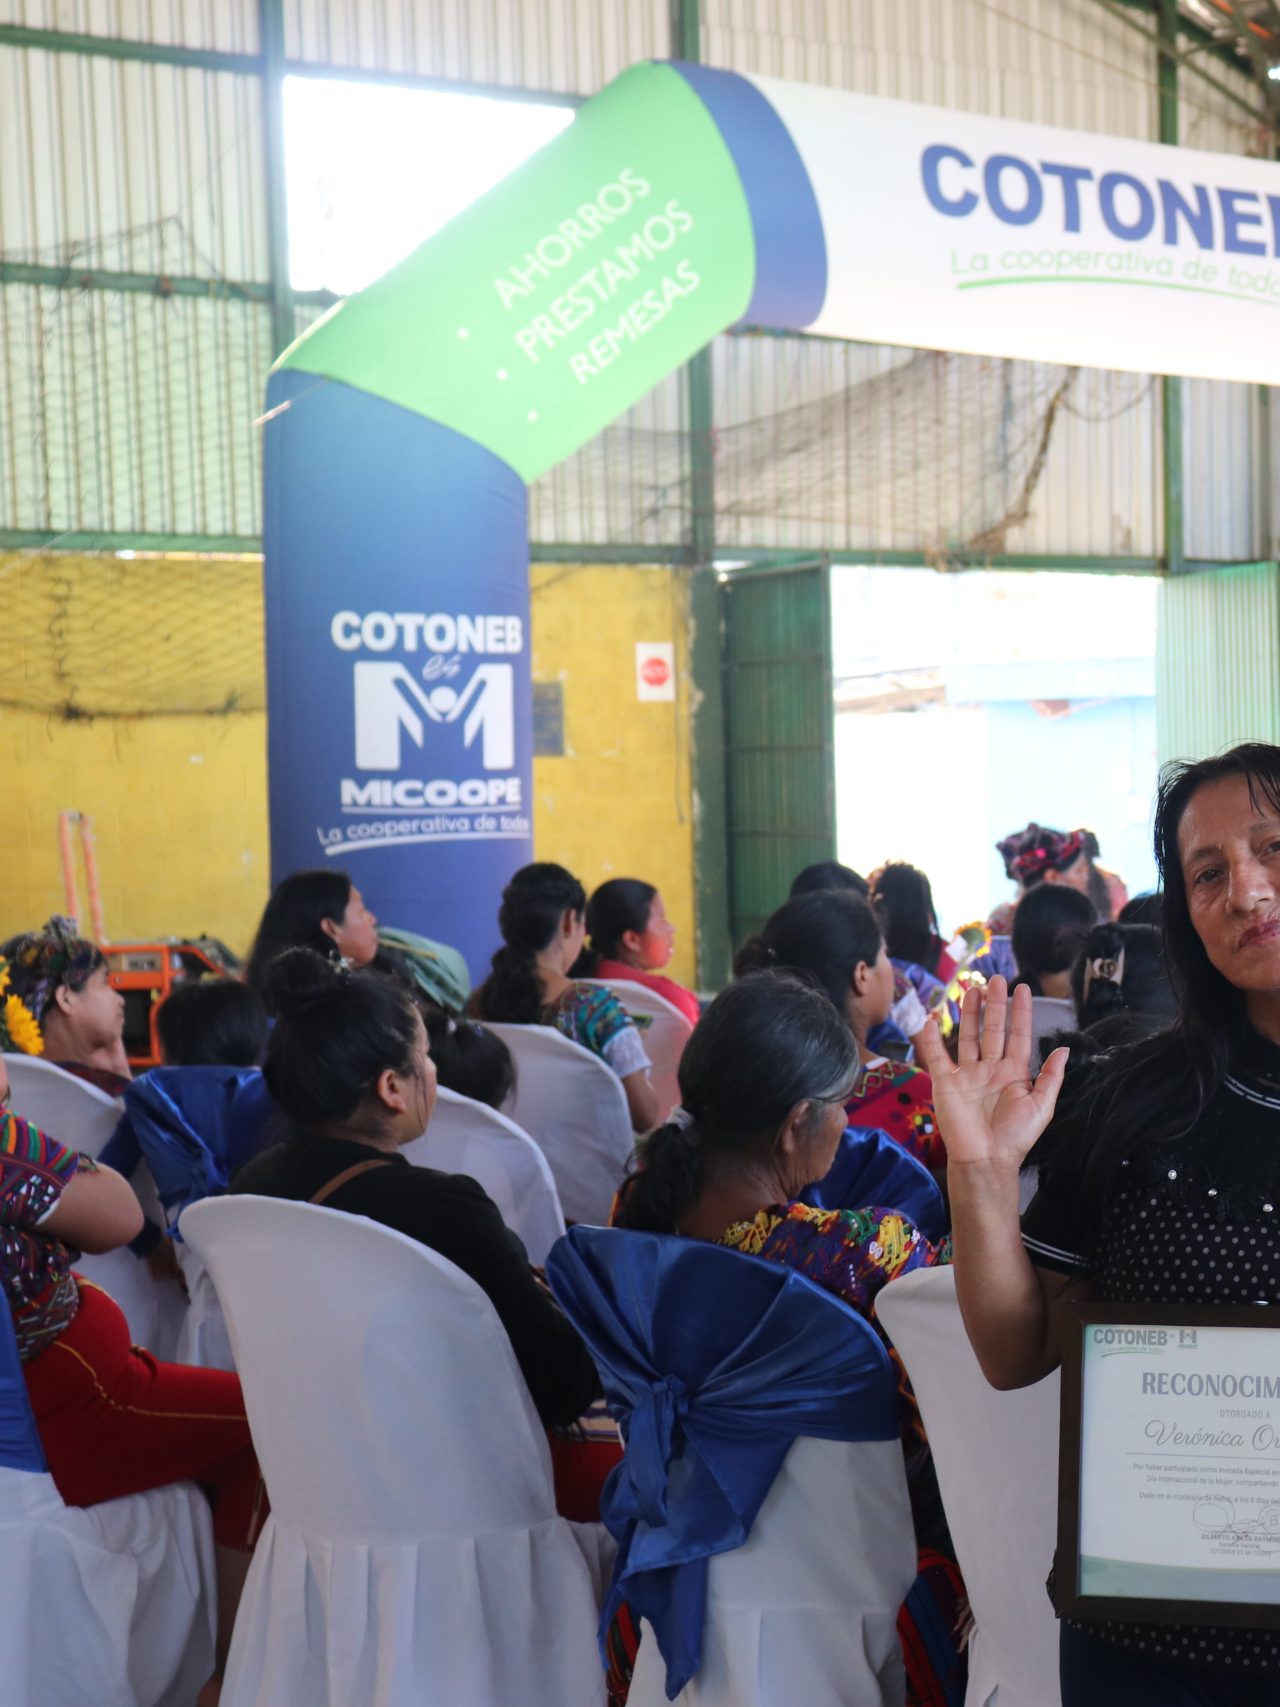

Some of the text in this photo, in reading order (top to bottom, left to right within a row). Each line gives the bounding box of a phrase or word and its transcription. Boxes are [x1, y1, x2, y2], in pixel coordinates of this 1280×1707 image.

[494, 167, 651, 311] AHORROS
[514, 198, 694, 364] PRESTAMOS
[950, 249, 989, 275] La
[1001, 247, 1173, 276] cooperativa
[1184, 256, 1219, 283] de
[568, 260, 701, 385] REMESAS
[330, 610, 523, 654] COTONEB
[341, 777, 522, 807] MICOOPE
[316, 825, 342, 846] La
[346, 814, 471, 838] cooperativa
[474, 812, 499, 831] de
[1093, 1328, 1168, 1346] COTONEB
[1219, 1409, 1264, 1419] OTORGADO
[1144, 1419, 1245, 1448] Verónica
